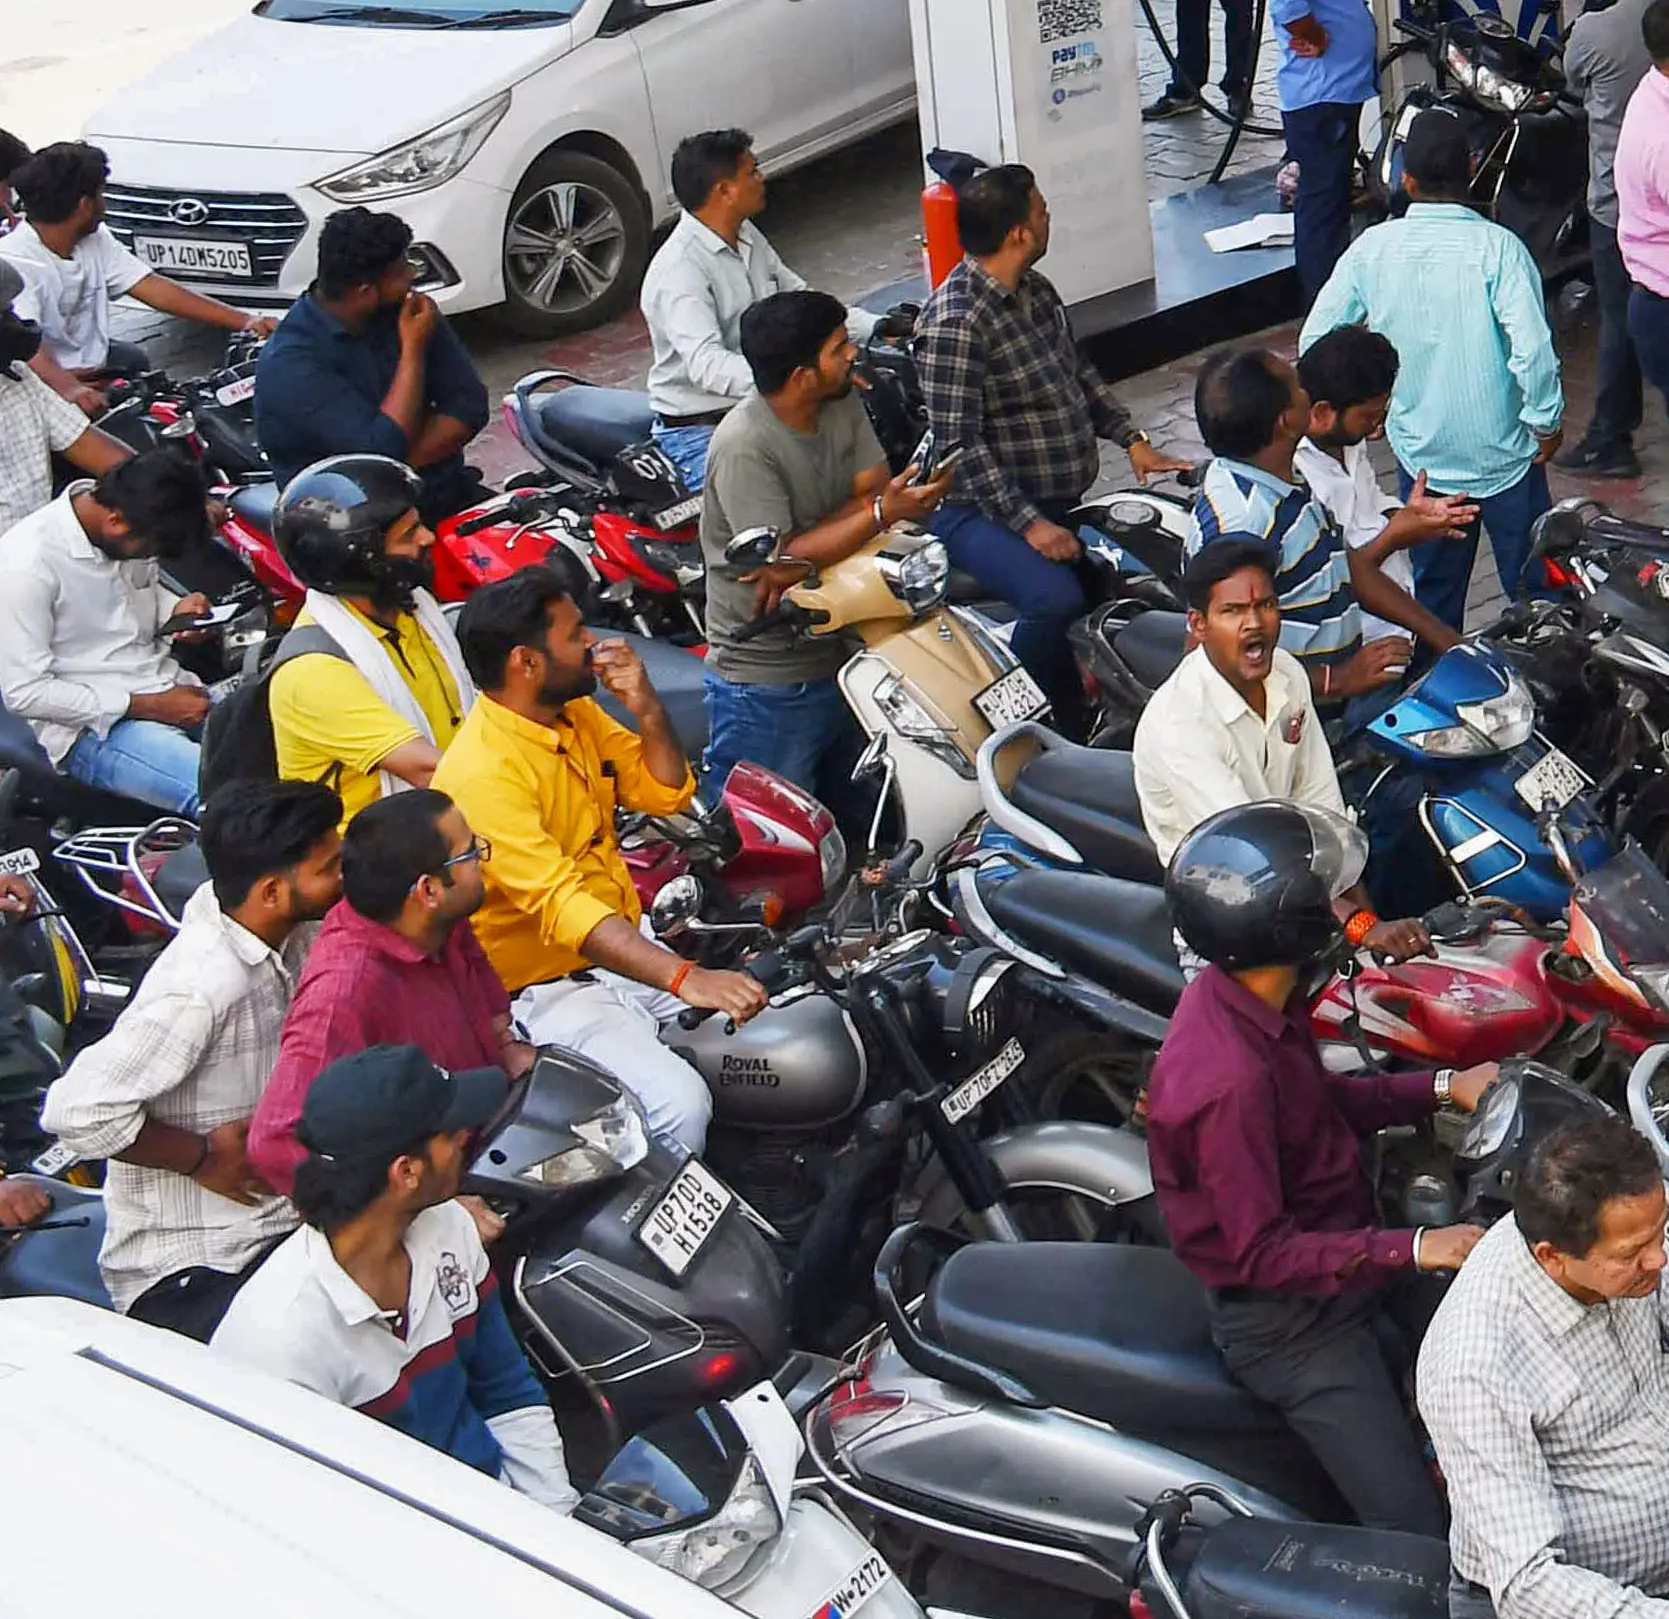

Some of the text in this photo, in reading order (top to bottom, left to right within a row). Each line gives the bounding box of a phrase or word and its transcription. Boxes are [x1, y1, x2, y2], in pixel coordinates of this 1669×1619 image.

[719, 1071, 781, 1089] ENFIELD
[722, 1053, 772, 1071] ROYAL
[653, 1172, 703, 1235] UP70D
[672, 1190, 722, 1256] H1538
[855, 1557, 887, 1597] 2172
